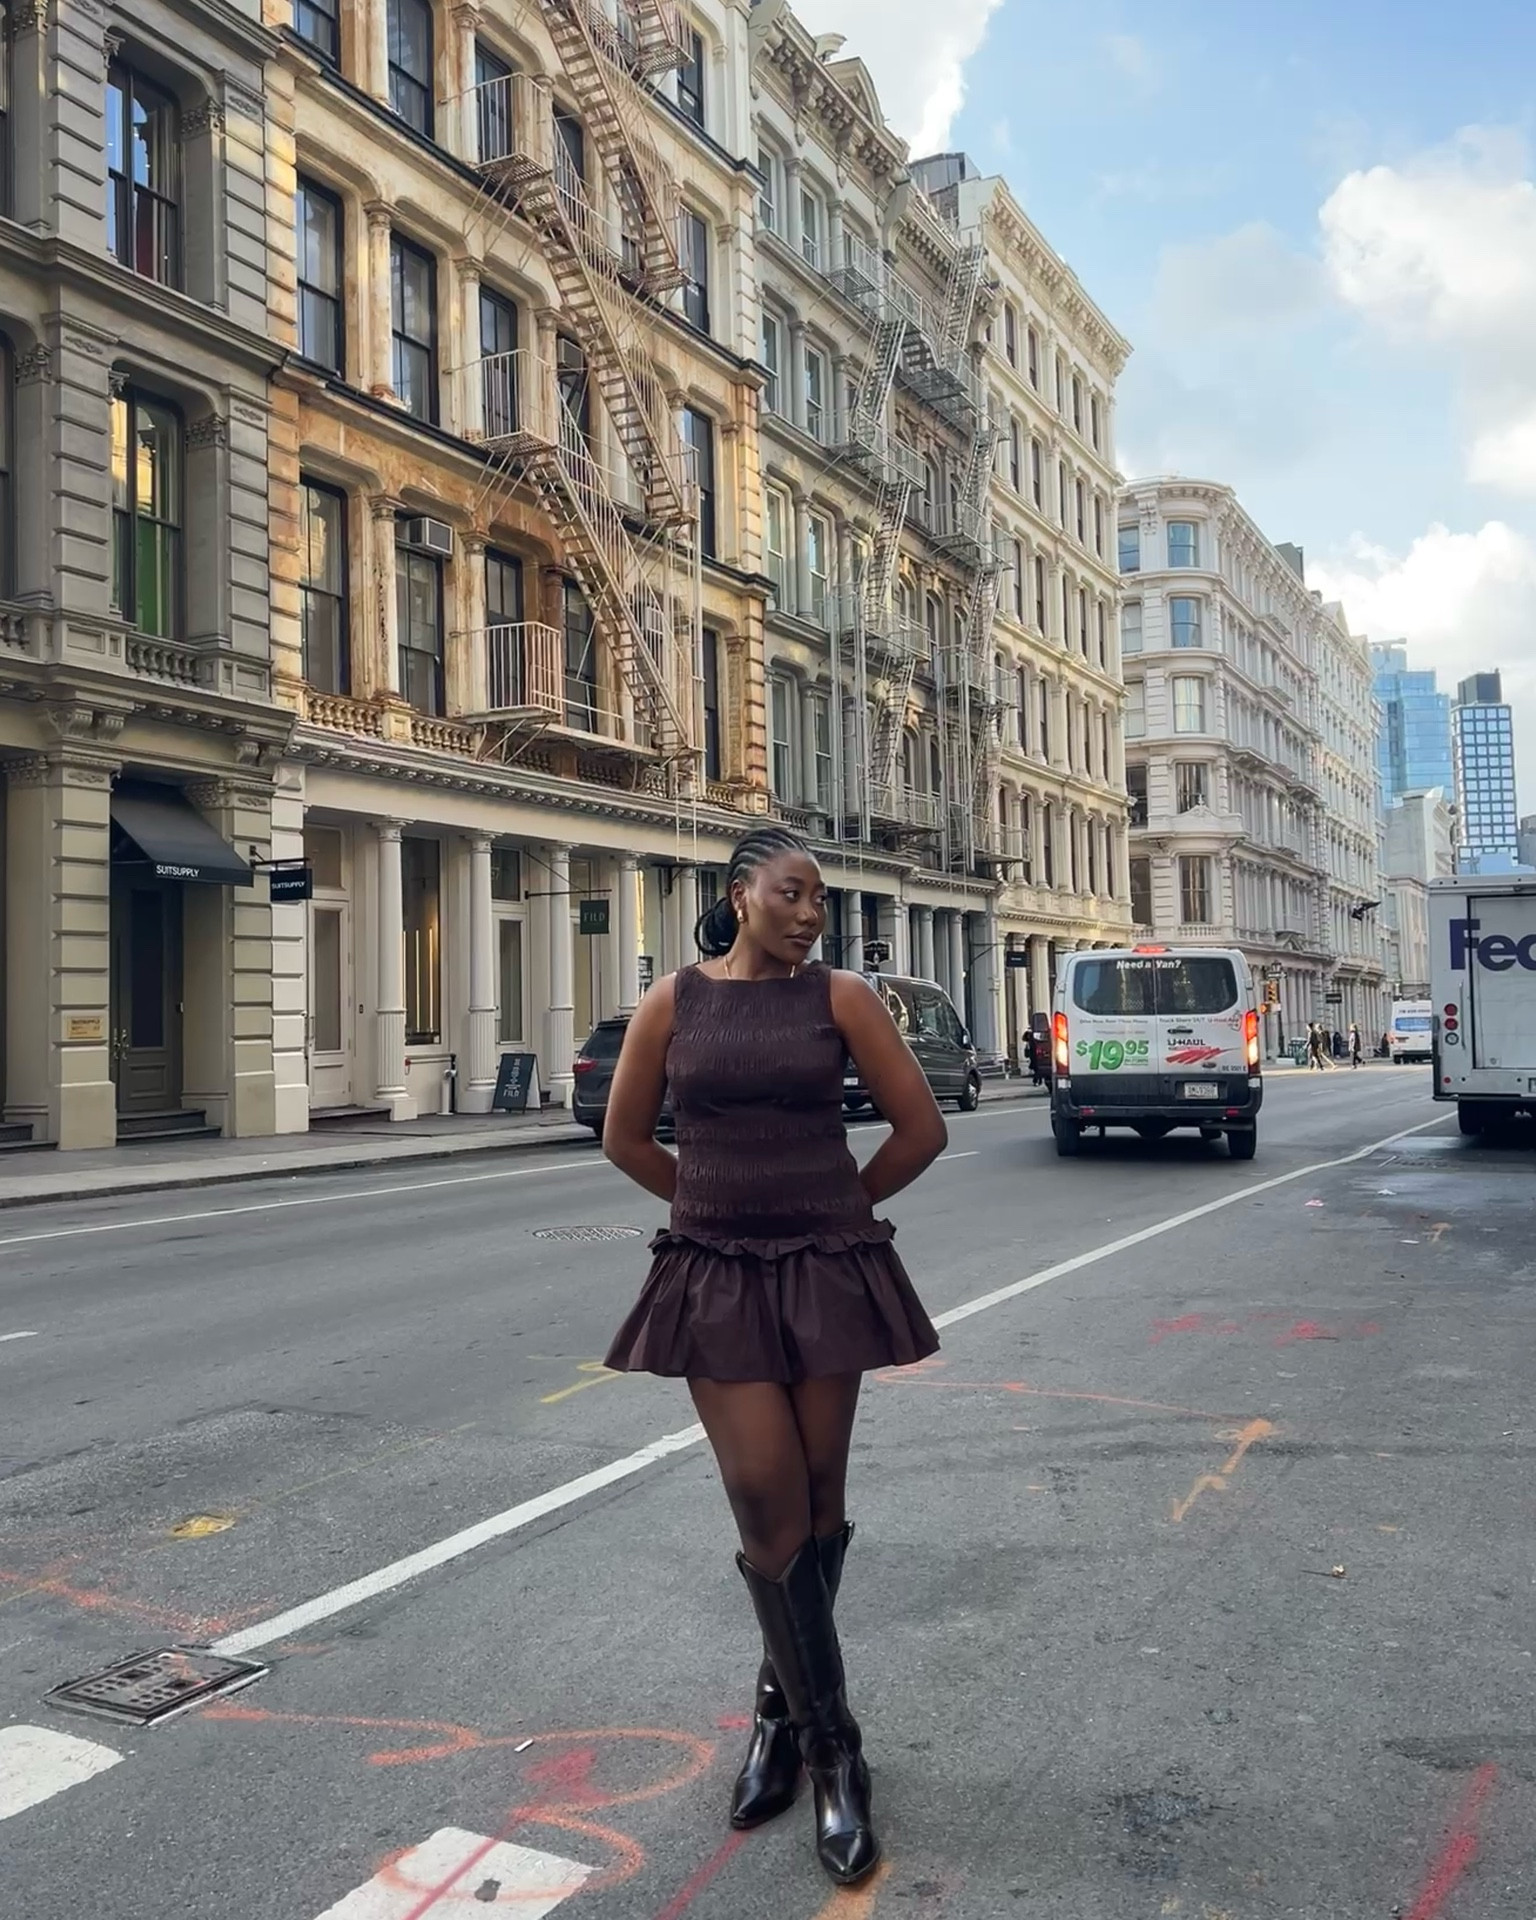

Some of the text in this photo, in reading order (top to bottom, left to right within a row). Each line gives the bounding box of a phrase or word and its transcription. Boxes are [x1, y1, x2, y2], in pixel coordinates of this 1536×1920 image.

[156, 865, 200, 877] SUITSUPPLY
[271, 881, 305, 889] SUITSUPPLY
[1116, 960, 1144, 969] Need
[1156, 960, 1182, 969] Van?
